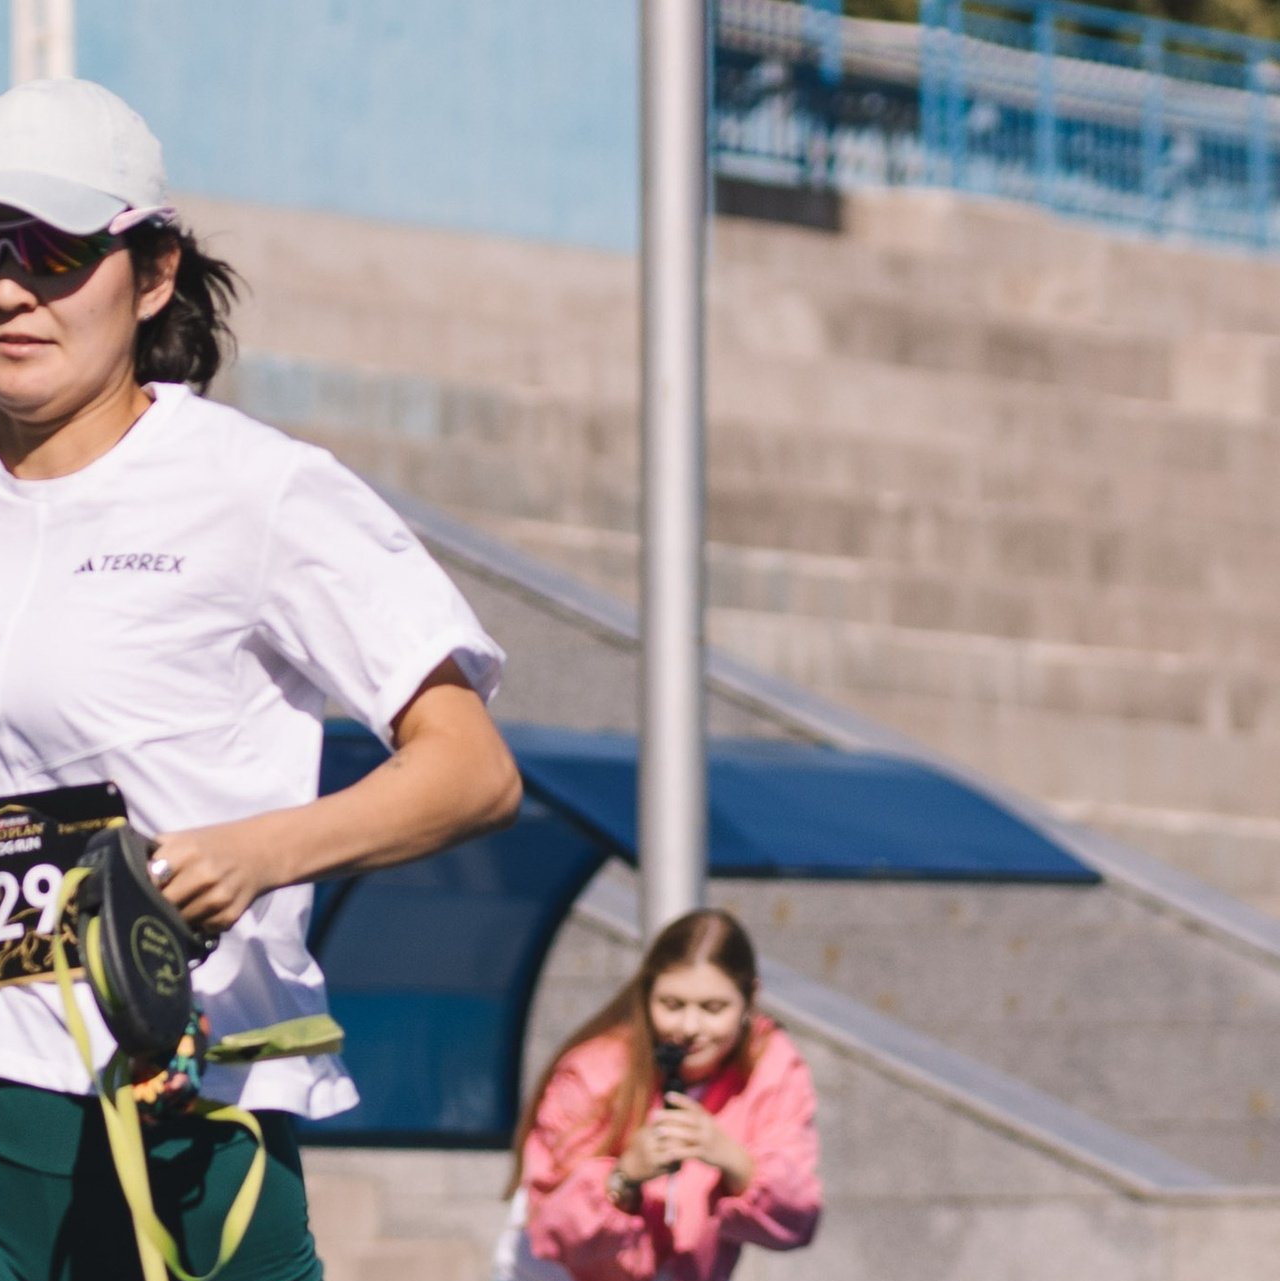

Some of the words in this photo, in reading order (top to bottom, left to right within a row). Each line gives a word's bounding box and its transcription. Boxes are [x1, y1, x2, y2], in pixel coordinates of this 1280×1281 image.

[100, 552, 186, 574] TERREX
[8, 821, 45, 839] PLAN
[14, 835, 42, 853] RUN
